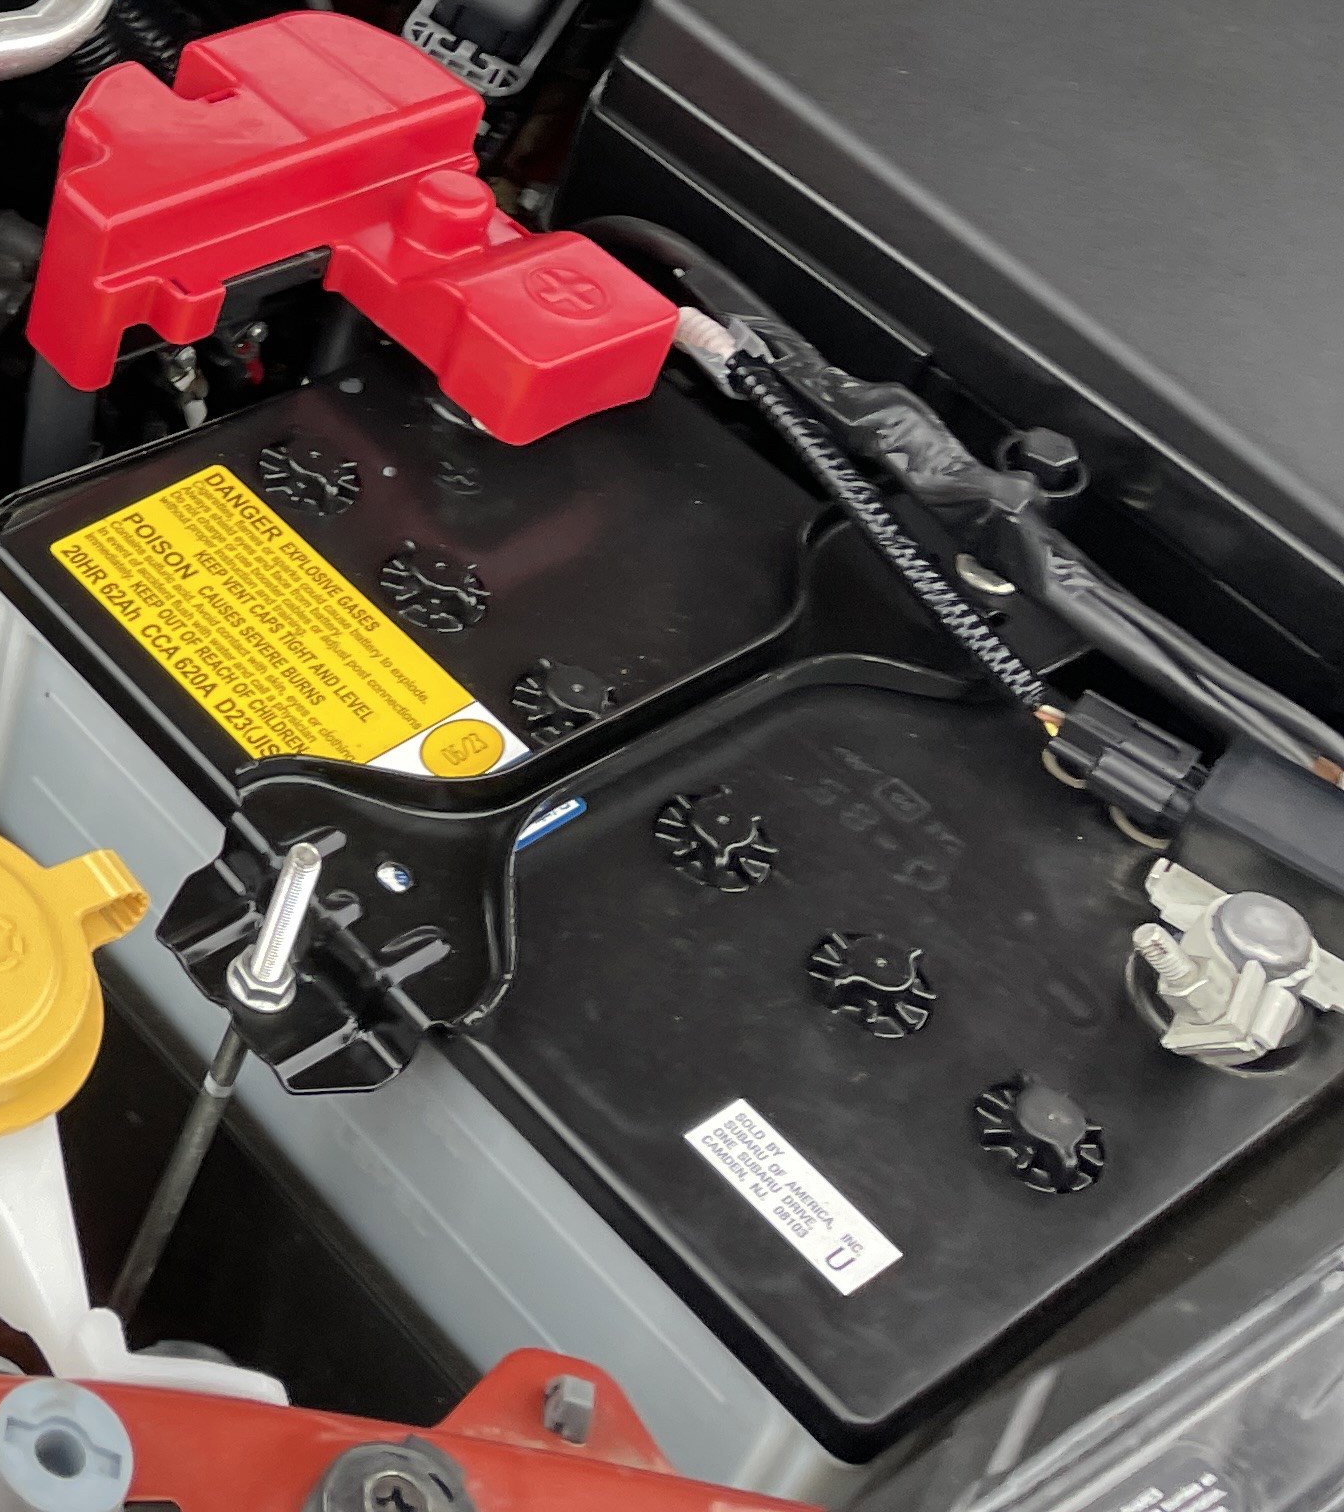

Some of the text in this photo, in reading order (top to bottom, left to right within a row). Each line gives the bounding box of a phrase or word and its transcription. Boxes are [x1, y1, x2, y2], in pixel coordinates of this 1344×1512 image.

[158, 496, 191, 524] without
[183, 523, 217, 551] proper
[212, 548, 260, 589] instruction
[254, 587, 277, 606] and
[178, 484, 213, 513] Always
[207, 511, 238, 536] shield
[230, 535, 256, 556] eyes
[252, 554, 274, 571] and
[270, 570, 294, 590] face
[288, 587, 314, 609] from
[203, 471, 382, 633] DANGER EXPLOSIVE GASES
[232, 519, 266, 546] flames
[260, 545, 275, 557] or
[269, 554, 304, 583] sparks
[58, 542, 110, 585] 20HR
[97, 580, 147, 623] 62Ah
[137, 621, 185, 661] CCA
[170, 655, 222, 698] 620A
[96, 526, 319, 745] In event of accident flush with water and call a physician
[107, 520, 148, 556] Contains
[191, 601, 221, 626] Avoid
[214, 625, 252, 657] contact
[245, 655, 269, 674] with
[282, 694, 310, 718] eyes
[306, 716, 321, 727] or
[120, 511, 328, 706] POISON CAUSES SEVERE BURNS
[128, 579, 166, 611] KEEP
[155, 607, 187, 633] OUT
[177, 629, 203, 648] OF
[192, 645, 240, 685] REACH
[229, 681, 255, 701] OF
[168, 490, 424, 730] Do not charge or use booster cables or adjust post connections
[192, 549, 378, 723] KEEP VENT CAPS TIGHT AND LEVEL
[298, 581, 328, 604] could
[321, 603, 353, 630] cause
[345, 628, 385, 660] battery
[378, 656, 394, 668] to
[385, 666, 433, 706] explode.
[698, 1133, 751, 1182] CAMDEN,
[771, 1204, 810, 1239] 08103
[710, 1126, 738, 1150] ONE
[736, 1150, 783, 1194] SUBARU
[722, 1118, 769, 1162] SUBARU
[766, 1161, 787, 1179] OF
[782, 1178, 839, 1230] AMERICA,
[733, 1111, 785, 1159] SOLD BY
[822, 1246, 856, 1273] U
